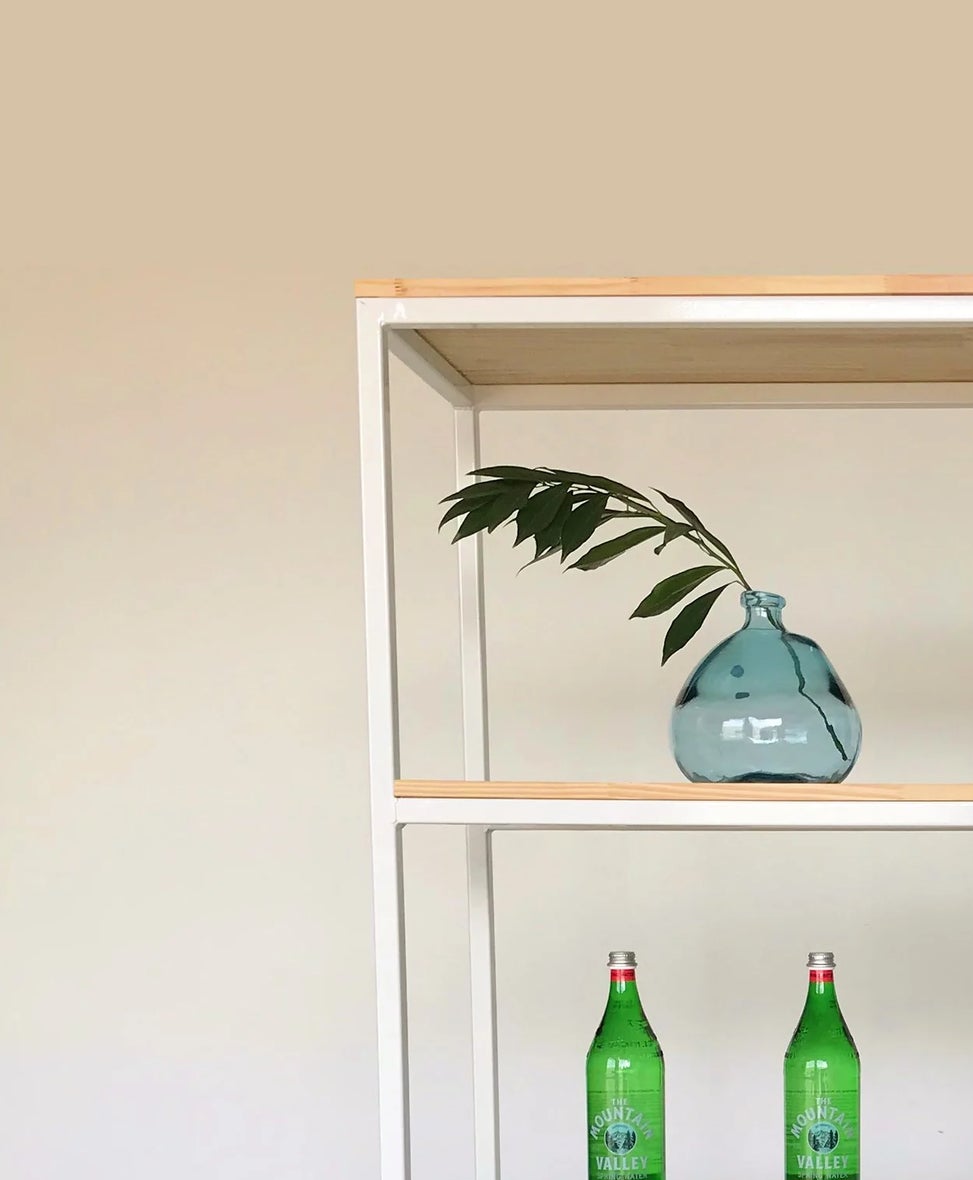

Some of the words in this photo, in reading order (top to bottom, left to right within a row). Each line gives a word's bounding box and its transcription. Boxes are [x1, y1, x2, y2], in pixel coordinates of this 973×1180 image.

[590, 1106, 655, 1140] MOUNTAIN
[790, 1105, 855, 1140] MOUNTAIN
[596, 1156, 648, 1171] VALLEY
[797, 1155, 849, 1170] VALLEY
